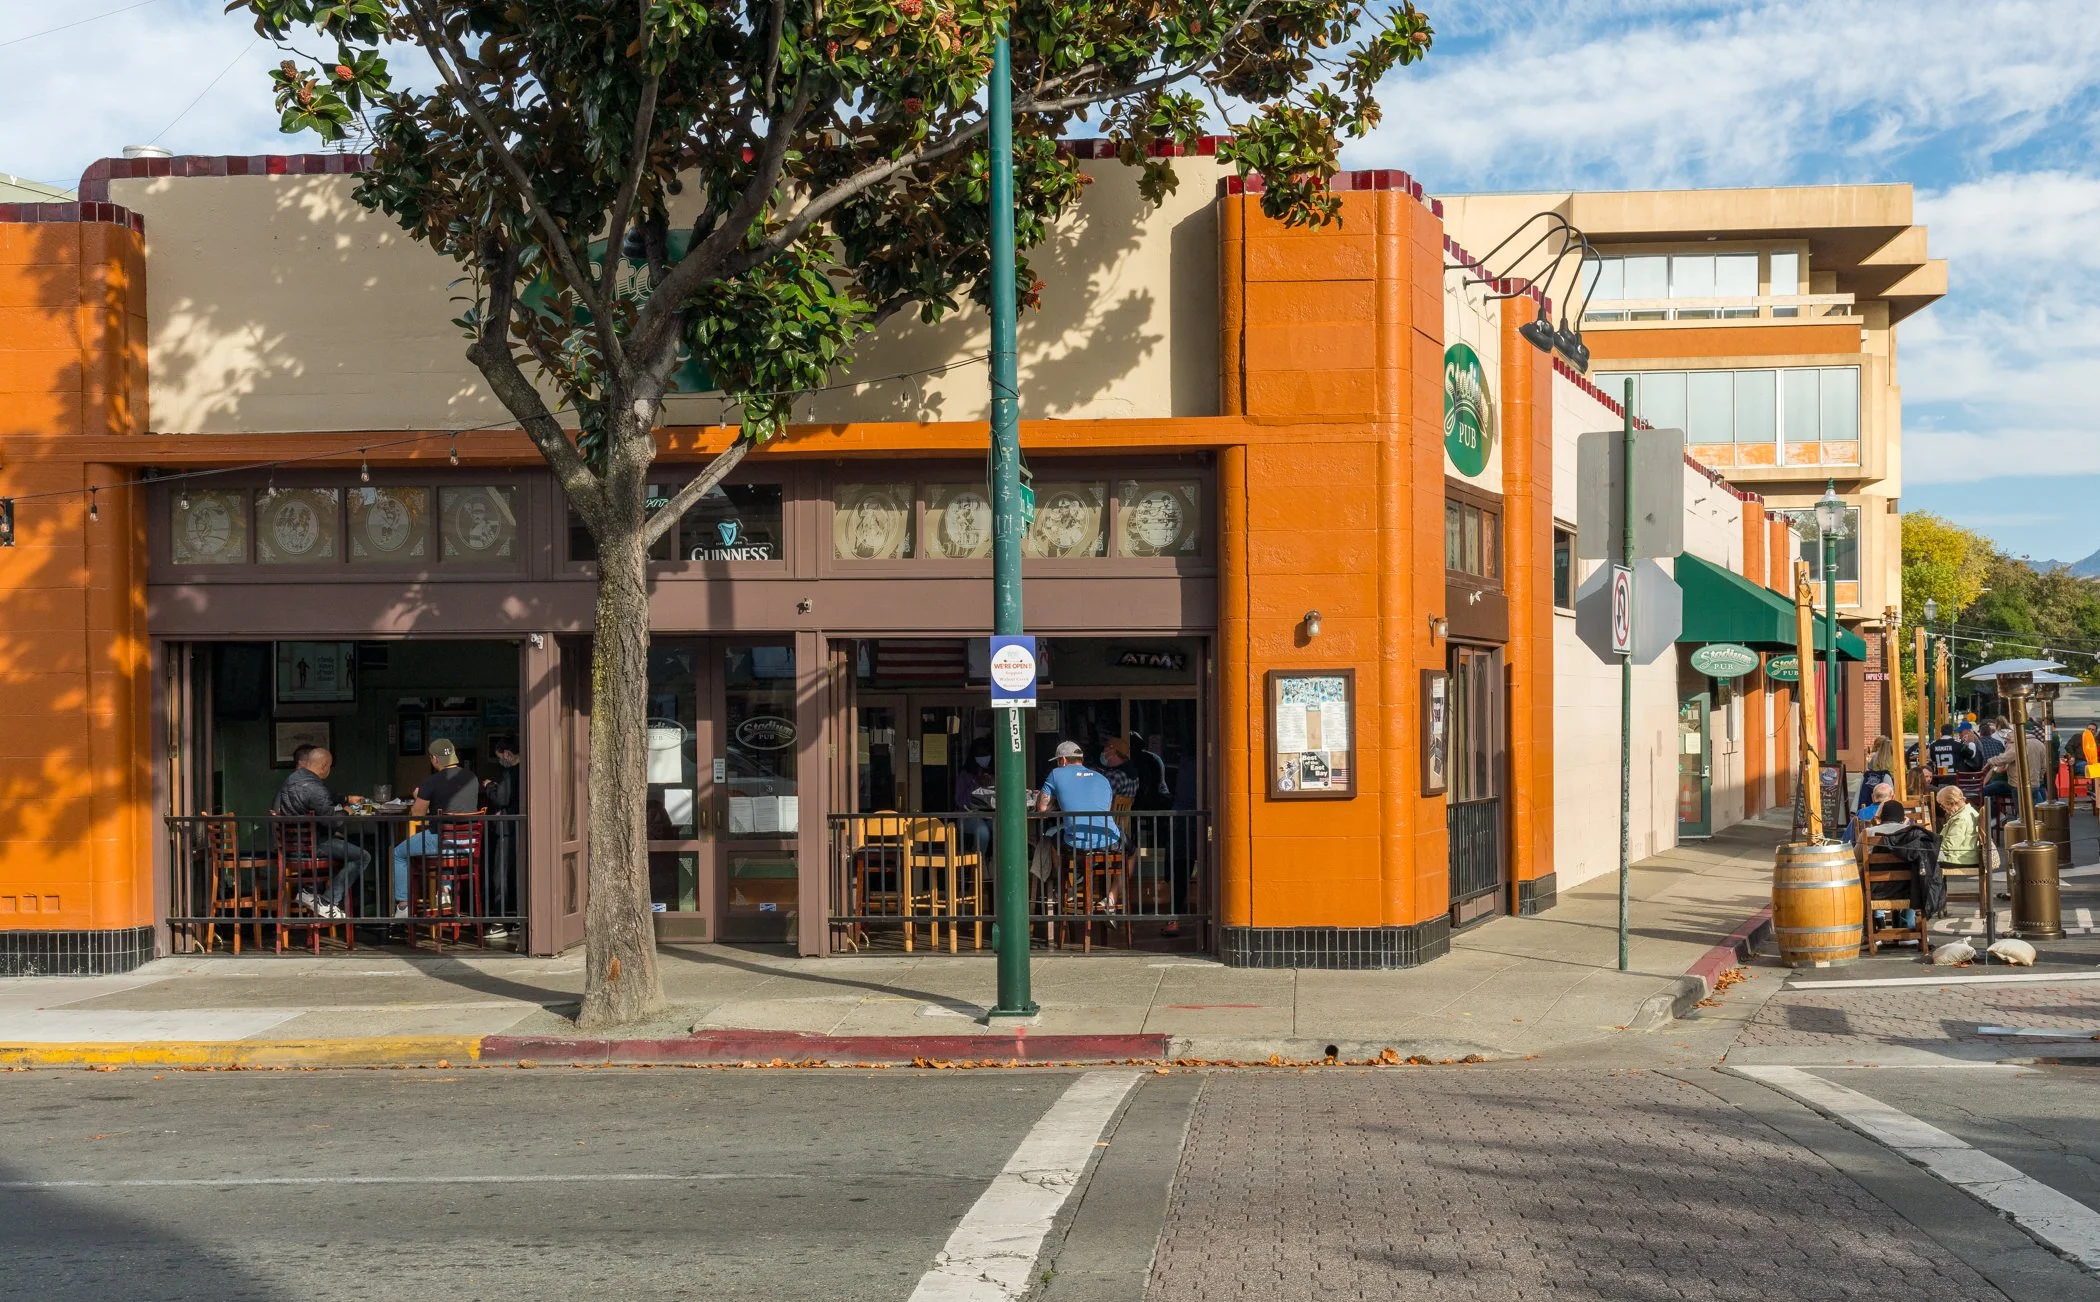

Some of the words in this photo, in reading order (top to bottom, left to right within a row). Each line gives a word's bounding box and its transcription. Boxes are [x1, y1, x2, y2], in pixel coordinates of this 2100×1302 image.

[1459, 421, 1477, 449] PUB
[691, 546, 769, 561] GUINNESS
[1700, 648, 1752, 669] Stadium
[1771, 657, 1798, 676] Stadi
[743, 720, 793, 742] Stadium
